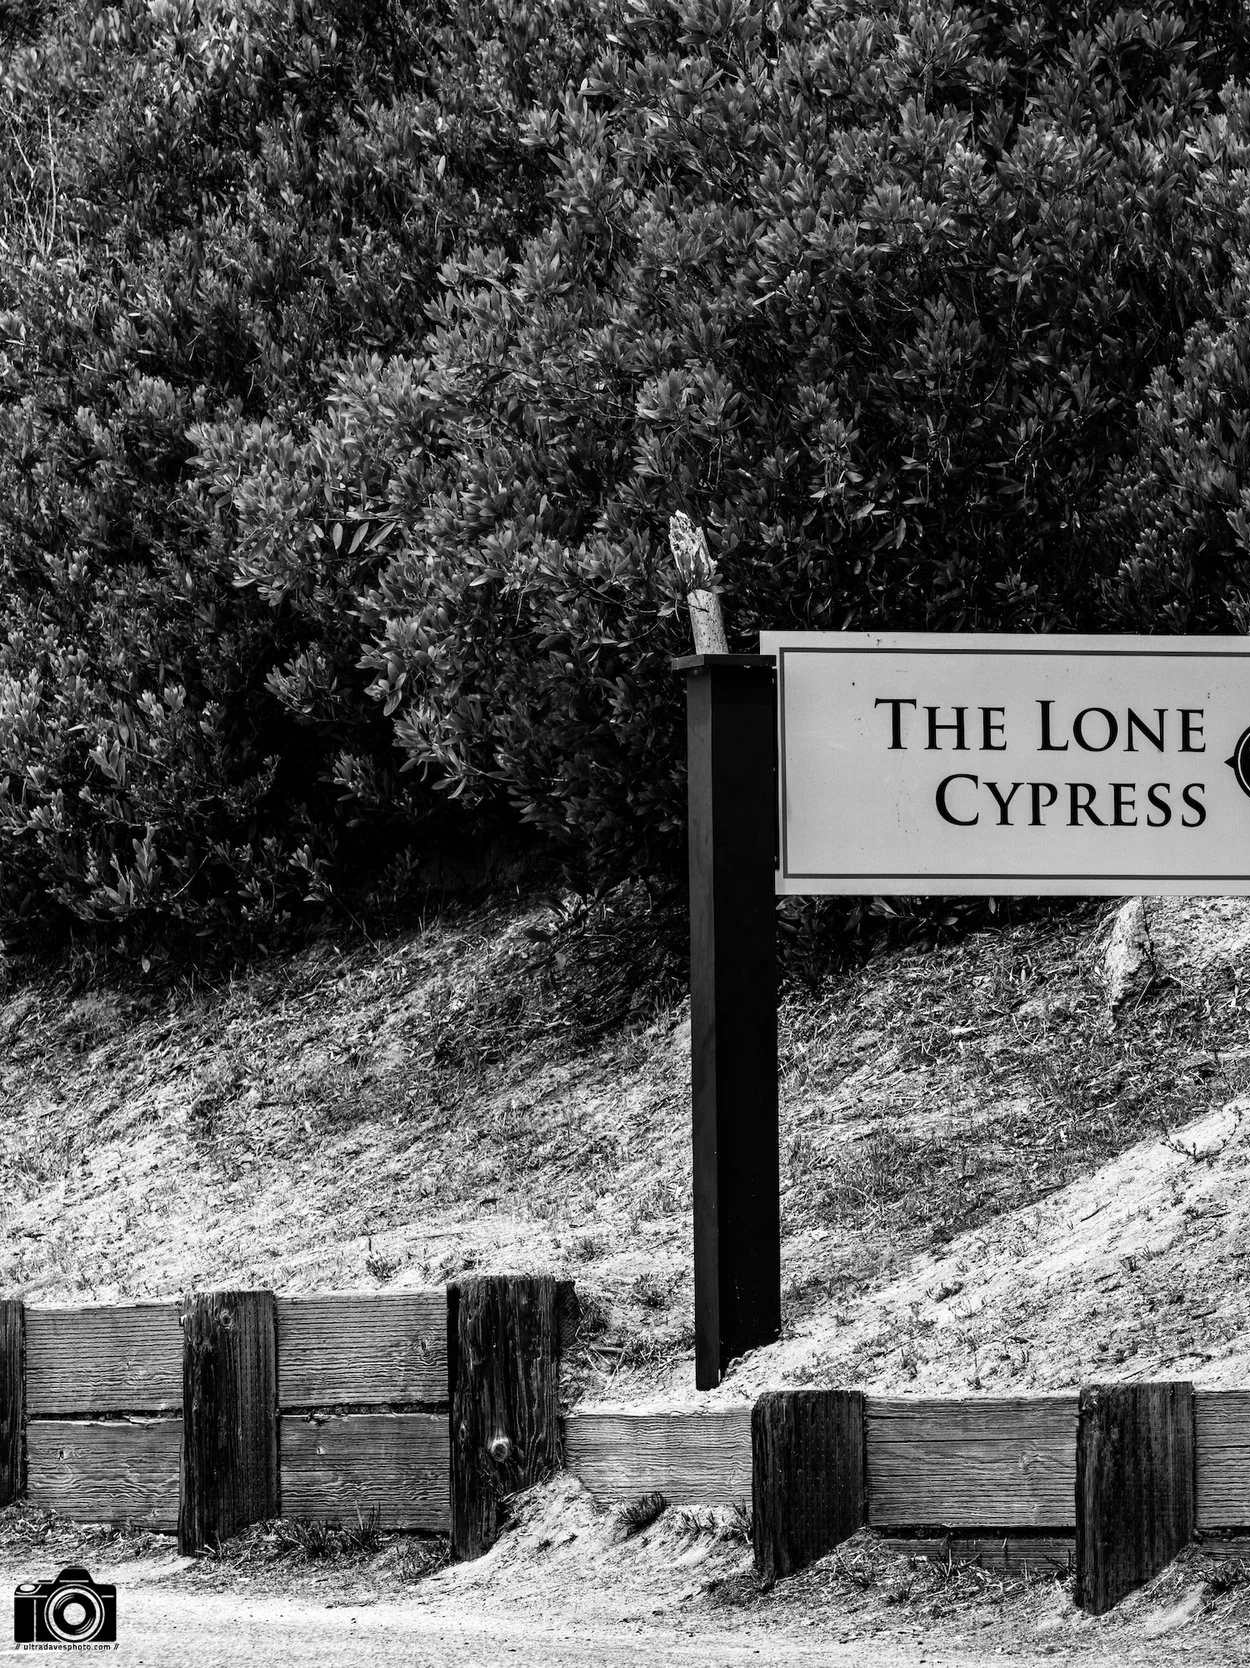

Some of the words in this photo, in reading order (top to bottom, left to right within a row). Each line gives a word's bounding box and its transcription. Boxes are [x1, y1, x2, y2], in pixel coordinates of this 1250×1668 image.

[874, 697, 1008, 752] THE
[1035, 699, 1207, 754] LONE
[935, 773, 1208, 828] CYPRESS
